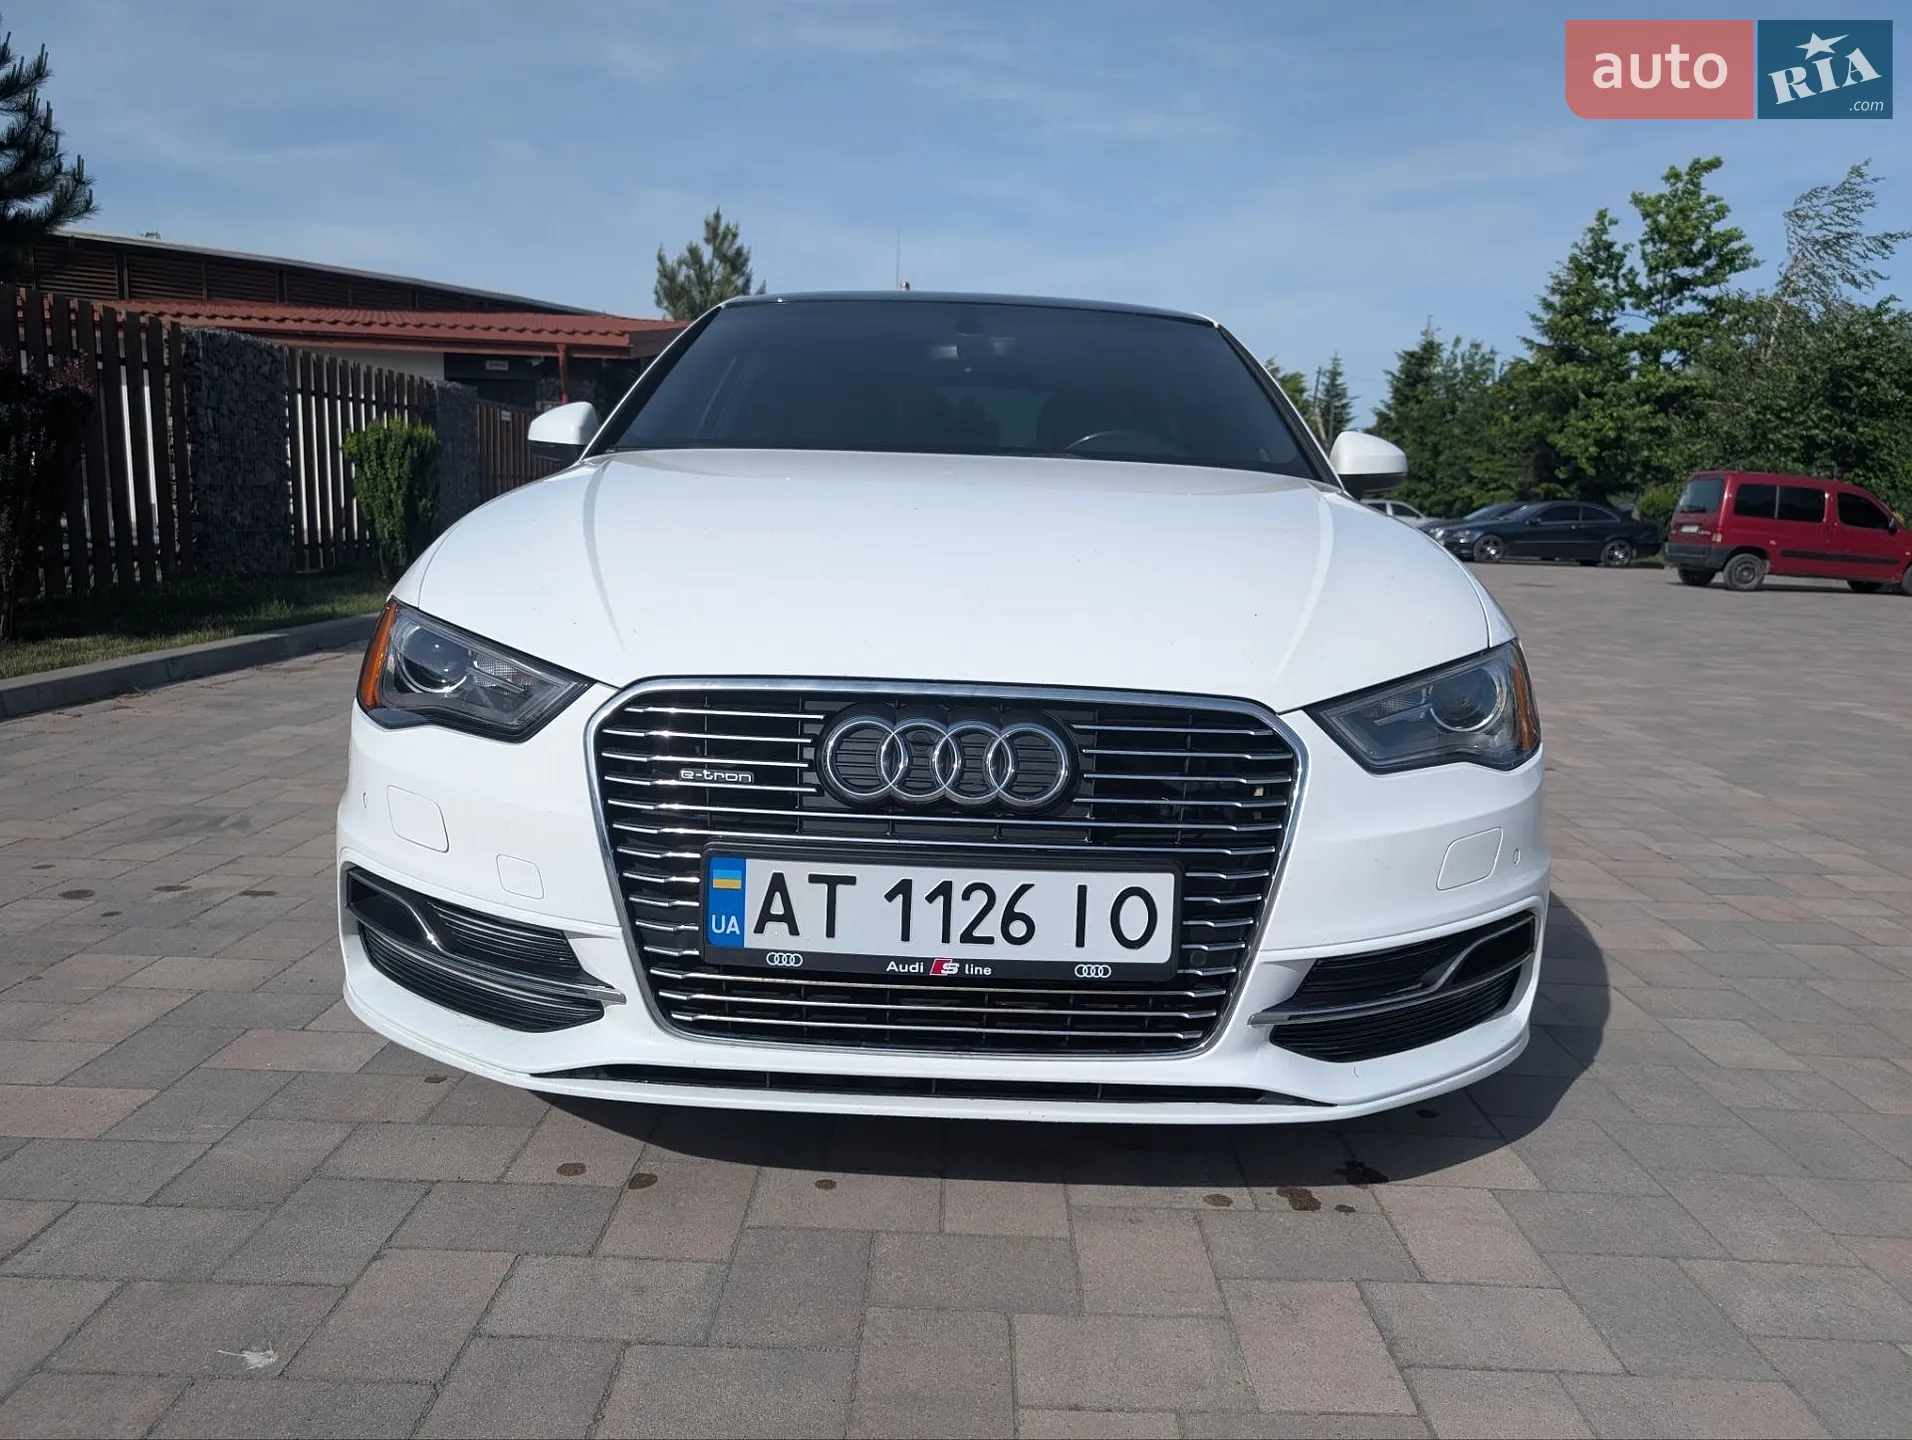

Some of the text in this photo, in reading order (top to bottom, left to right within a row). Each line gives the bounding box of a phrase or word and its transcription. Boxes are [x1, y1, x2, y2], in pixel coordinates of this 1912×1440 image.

[680, 769, 752, 783] e-tron
[753, 871, 857, 938] AT
[883, 878, 1036, 946] 1126
[711, 914, 740, 935] UA
[885, 961, 924, 973] Audi
[965, 963, 992, 976] line
